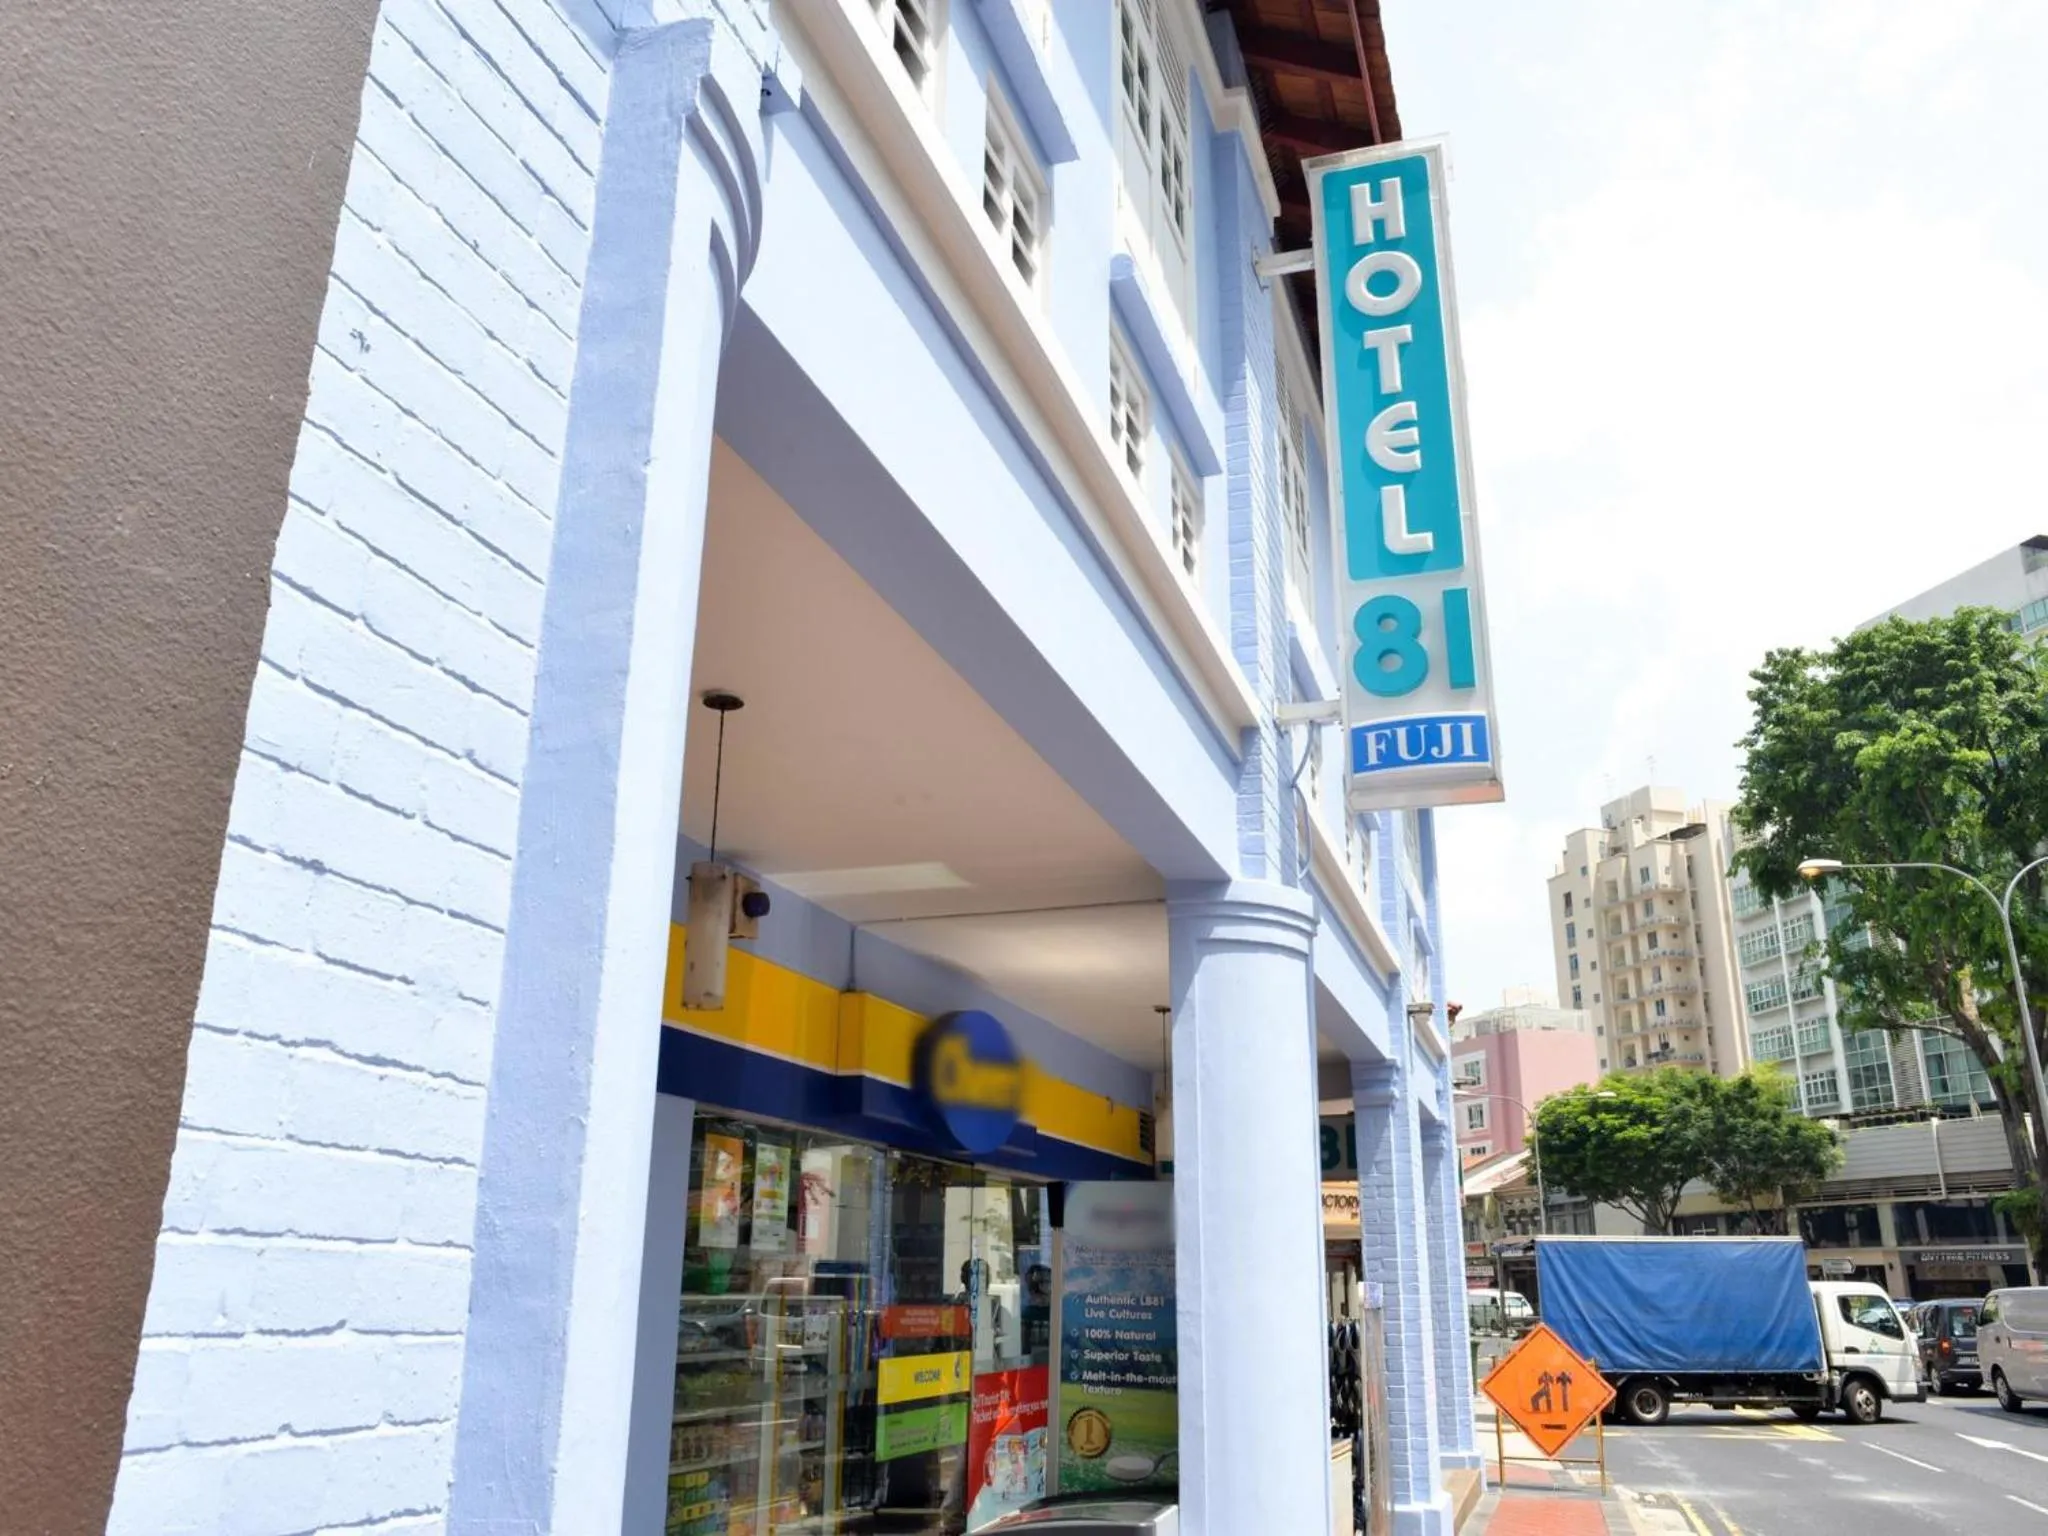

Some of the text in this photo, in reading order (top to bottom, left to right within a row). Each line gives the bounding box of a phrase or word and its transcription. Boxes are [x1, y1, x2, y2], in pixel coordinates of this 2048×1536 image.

[1345, 176, 1434, 558] HOTEL
[1353, 587, 1476, 698] 81
[1362, 721, 1481, 767] FUJI
[1085, 1294, 1136, 1306] Authentic
[1085, 1307, 1153, 1320] Live Cultures
[1085, 1327, 1156, 1341] 100% Natural
[1083, 1349, 1163, 1362] Superior Taste
[1082, 1370, 1178, 1384] Melt-in-the-mout
[1083, 1384, 1122, 1396] Texture
